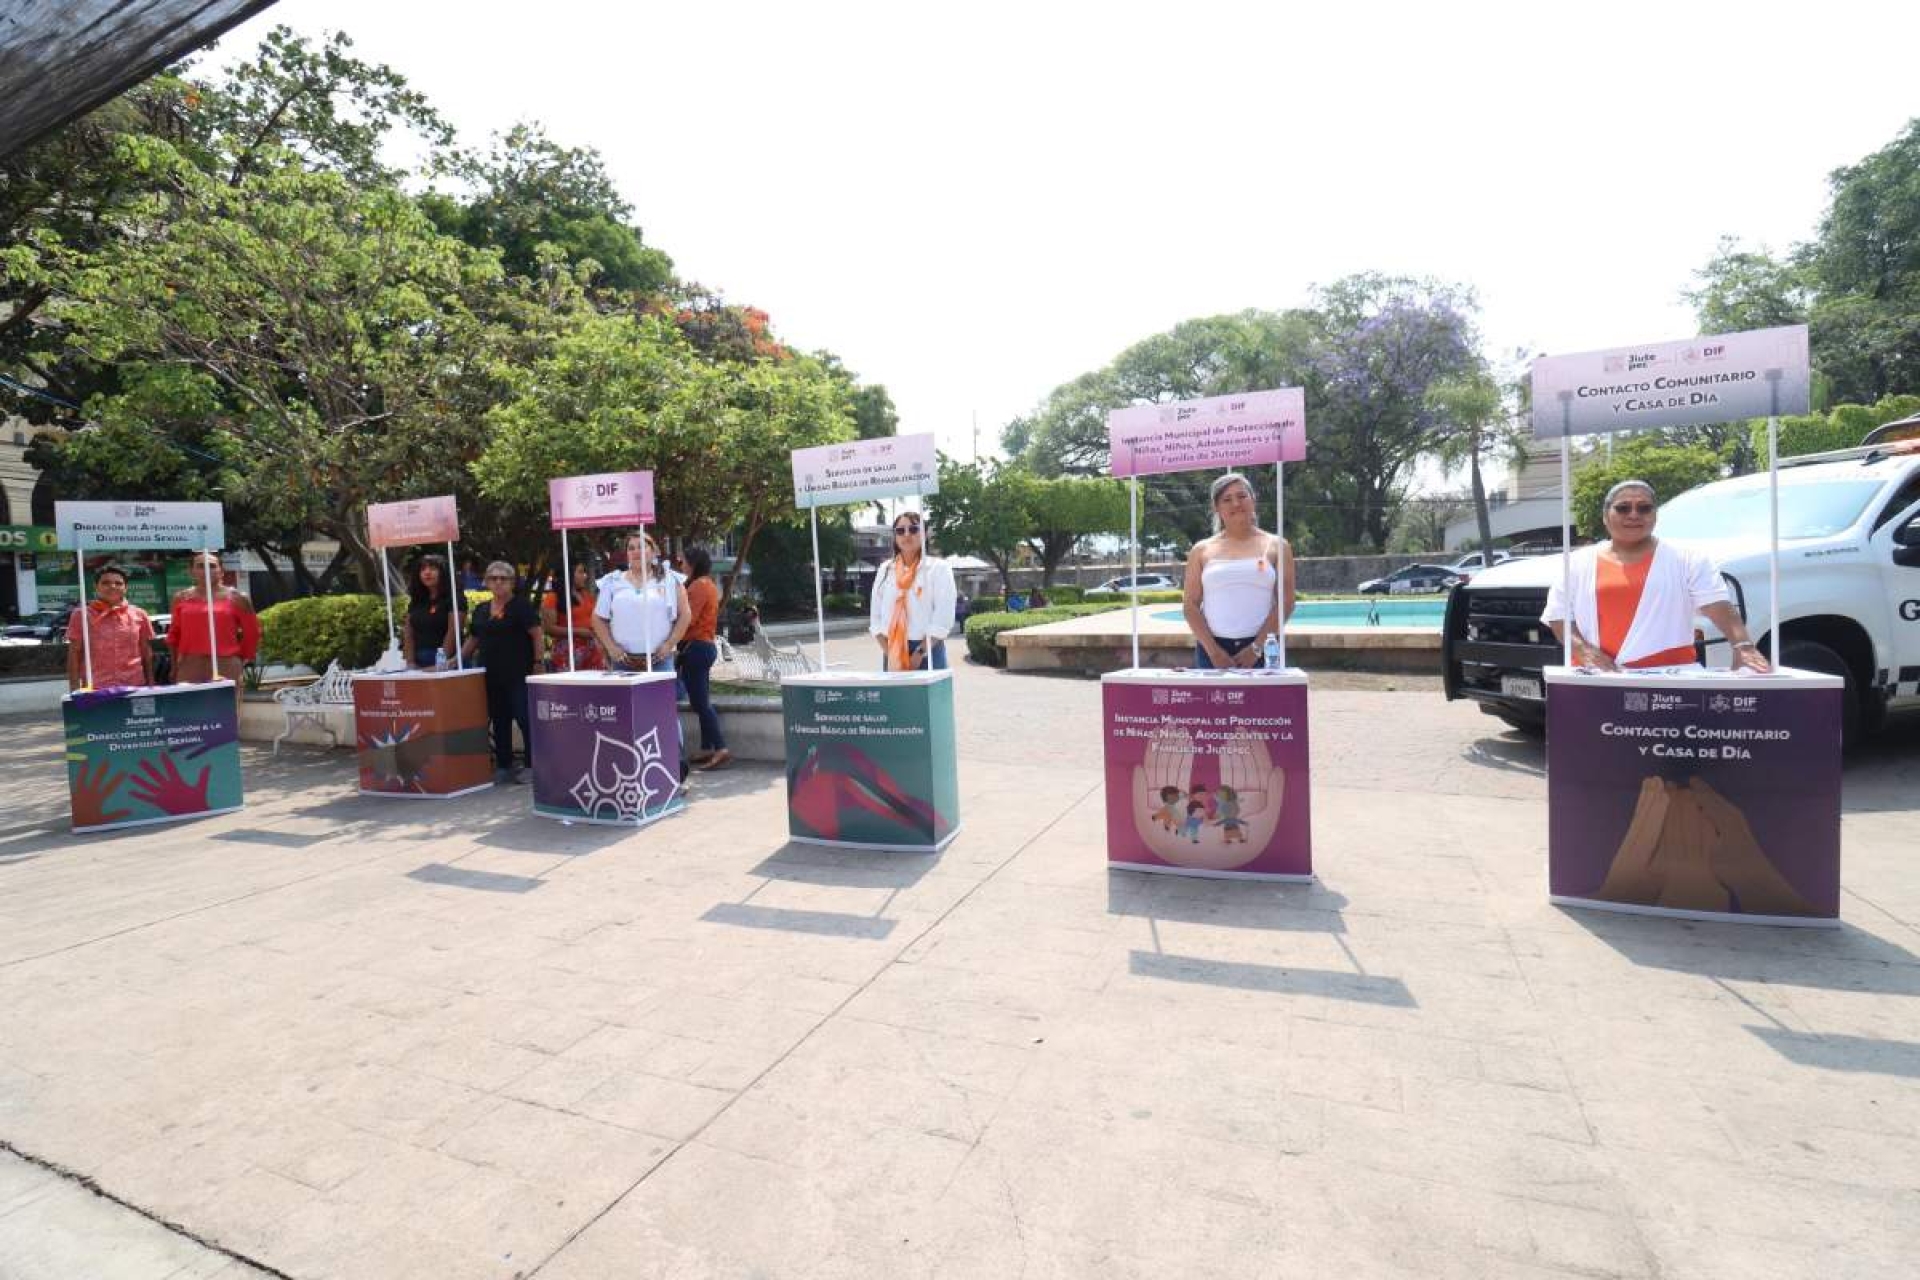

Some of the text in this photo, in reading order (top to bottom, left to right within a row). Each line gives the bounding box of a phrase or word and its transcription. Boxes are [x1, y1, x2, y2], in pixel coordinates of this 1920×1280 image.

[1703, 346, 1725, 356] DIF
[1577, 370, 1756, 398] CONTACTO COMUNITARIO
[1625, 399, 1663, 412] CASA
[1668, 397, 1686, 408] DE
[1164, 426, 1211, 440] Municipal
[1213, 426, 1225, 435] de
[596, 483, 619, 497] DIF
[1651, 703, 1673, 711] pec
[1733, 696, 1756, 707] DIF
[600, 706, 617, 716] DIF
[1114, 713, 1292, 726] INSTANCIA MUNICIPAL DE PROTECCIÓN
[1113, 728, 1125, 737] DE
[1195, 729, 1270, 740] ADOLESCENTES
[1272, 732, 1279, 740] Y
[1281, 732, 1294, 740] LA
[1600, 722, 1790, 740] CONTACTO COMUNITARIO
[1639, 744, 1751, 760] Y CASA DE DÍA
